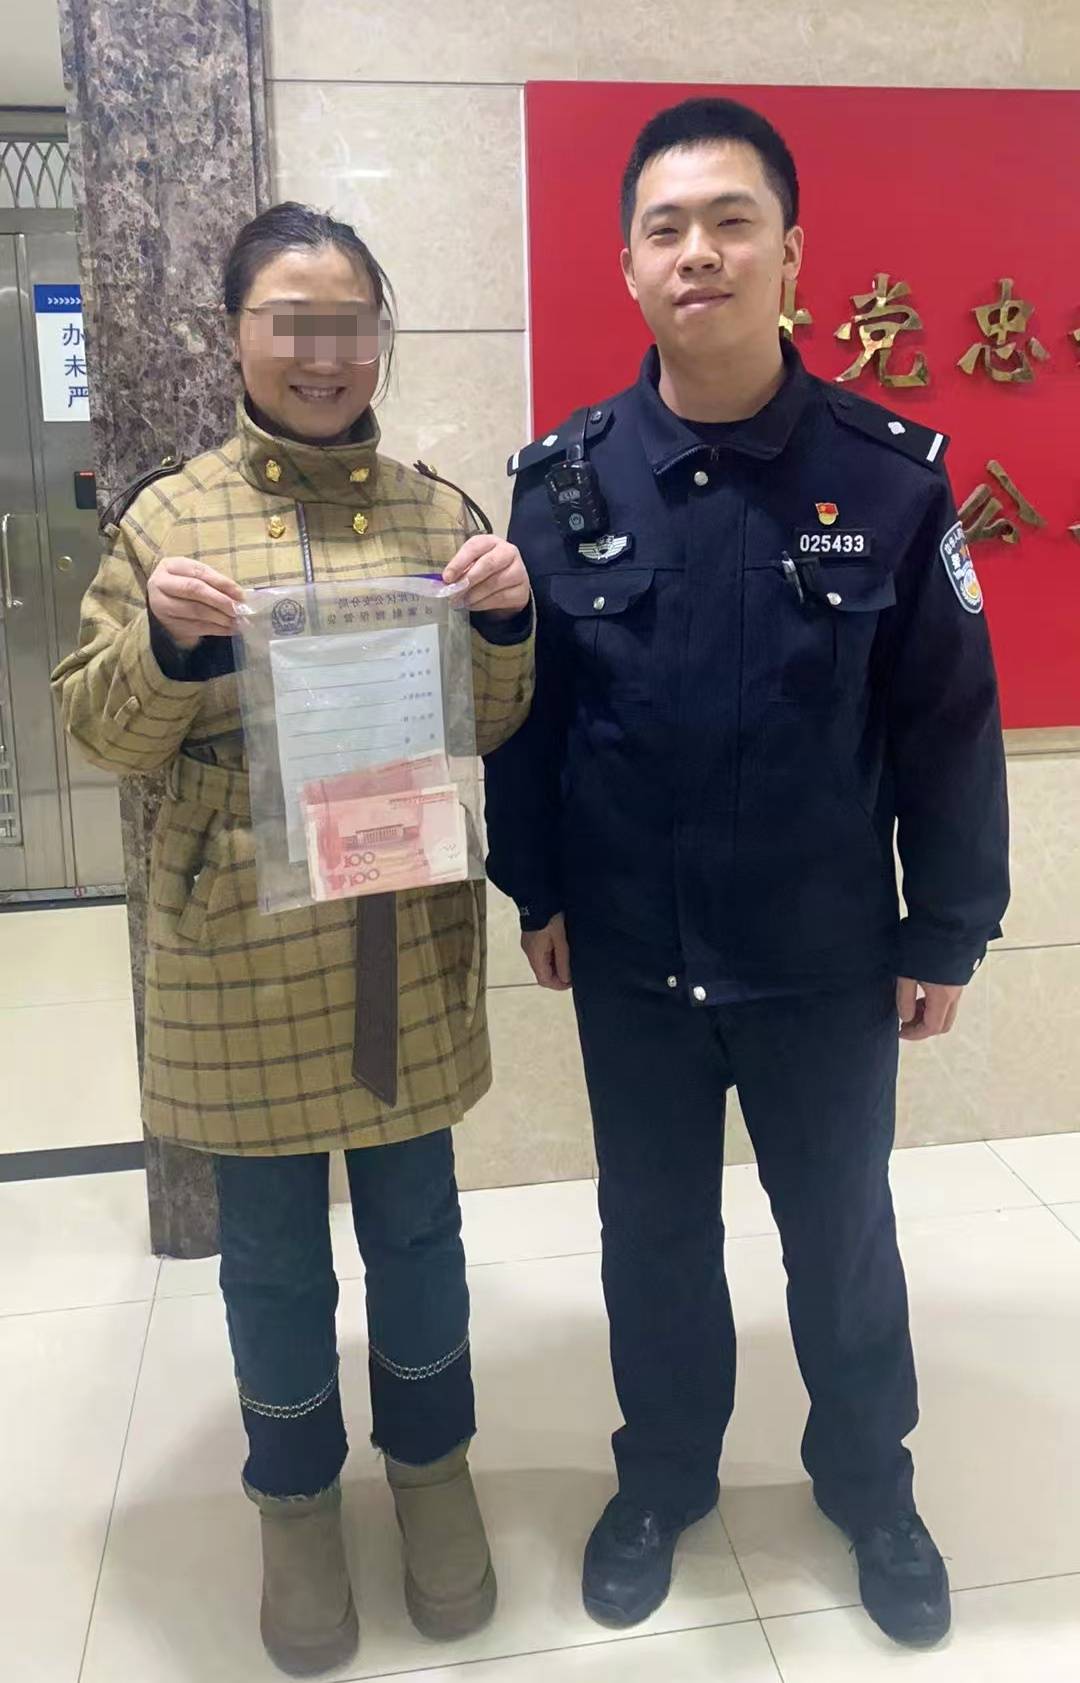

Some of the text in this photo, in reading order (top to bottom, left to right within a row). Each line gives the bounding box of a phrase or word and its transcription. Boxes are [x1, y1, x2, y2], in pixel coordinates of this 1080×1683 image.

[779, 273, 1080, 387] 党忠
[957, 460, 1080, 544] 公
[800, 535, 864, 552] 025433
[344, 851, 375, 868] 100
